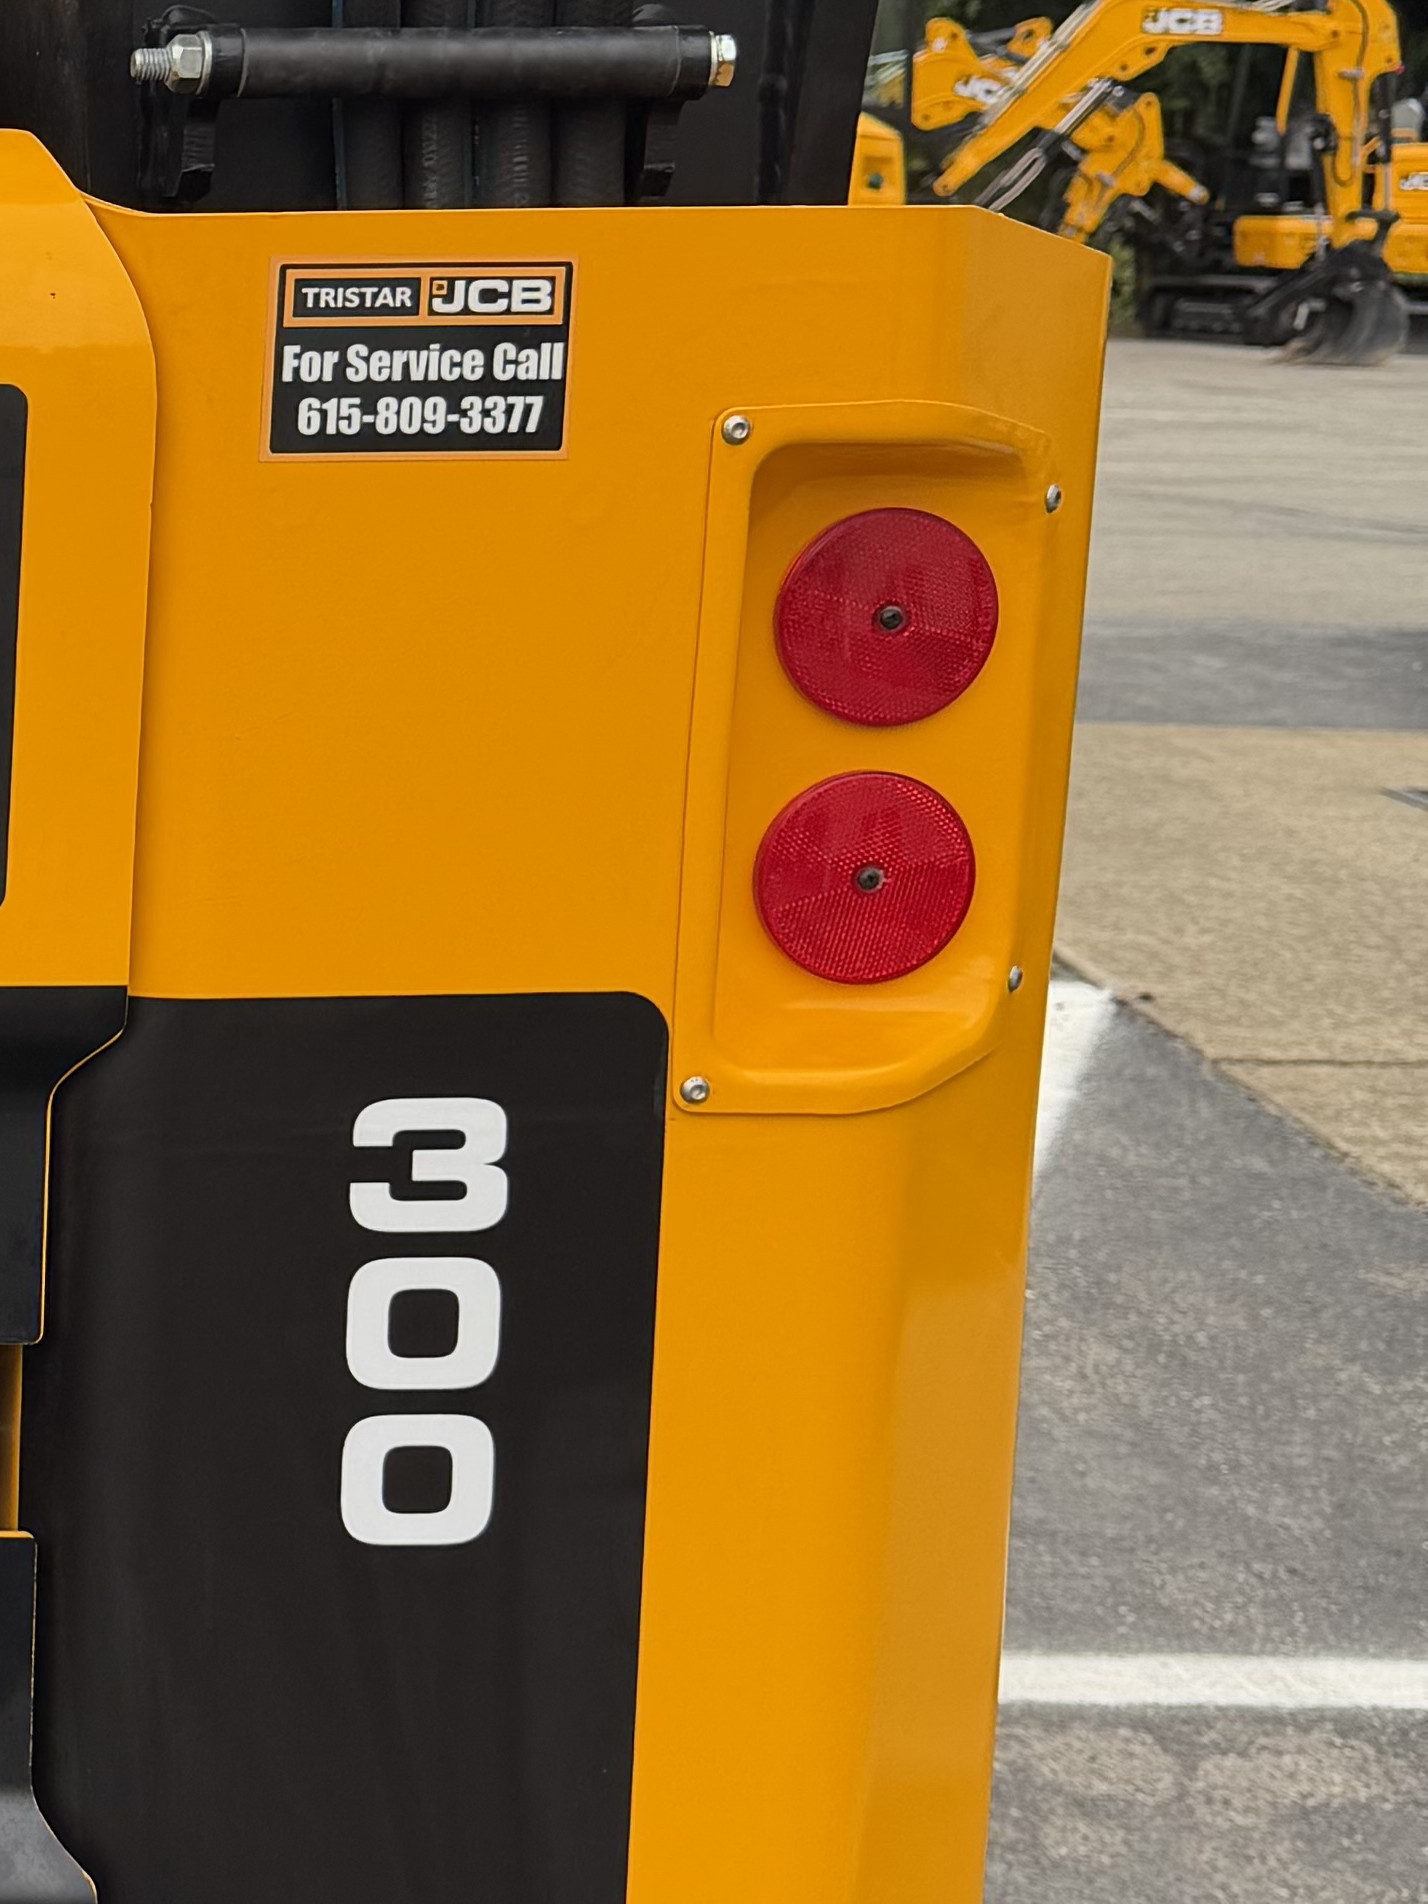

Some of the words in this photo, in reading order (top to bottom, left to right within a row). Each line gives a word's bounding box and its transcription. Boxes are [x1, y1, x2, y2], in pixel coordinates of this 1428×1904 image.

[1141, 8, 1222, 35] JCB
[953, 76, 1004, 105] JC
[301, 286, 413, 309] TRISTAR
[431, 278, 553, 314] JCB
[282, 344, 339, 383] For
[346, 342, 484, 382] Service
[493, 341, 565, 381] Call
[297, 395, 545, 435] 615-809-3377
[340, 1097, 508, 1546] 300
